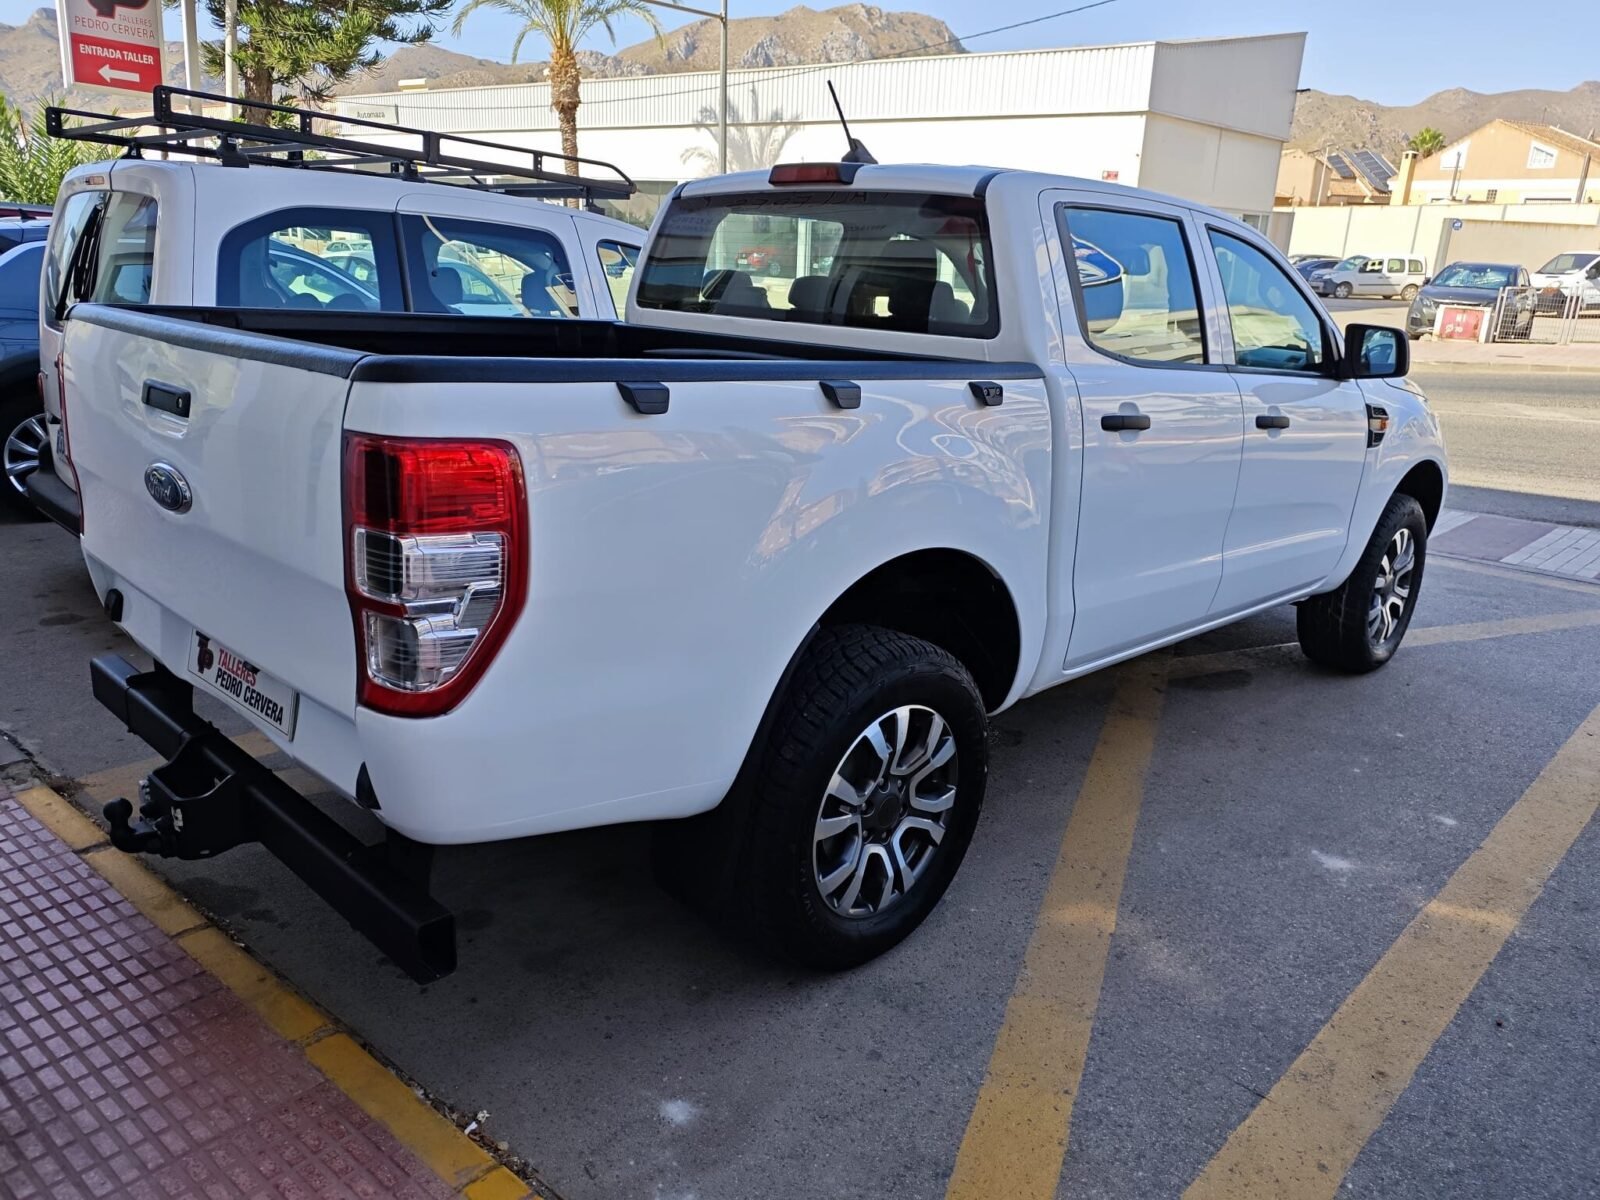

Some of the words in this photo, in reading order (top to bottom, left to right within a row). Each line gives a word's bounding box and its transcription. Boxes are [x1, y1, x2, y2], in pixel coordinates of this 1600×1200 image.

[75, 15, 109, 32] PEDRO
[112, 23, 155, 40] CERVERA
[119, 14, 152, 28] TALLERES
[79, 43, 122, 60] ENTRADA
[123, 51, 154, 65] TALLER
[218, 648, 257, 687] TALLERES
[215, 667, 243, 699] PEDRO
[243, 685, 284, 726] CERVERA
